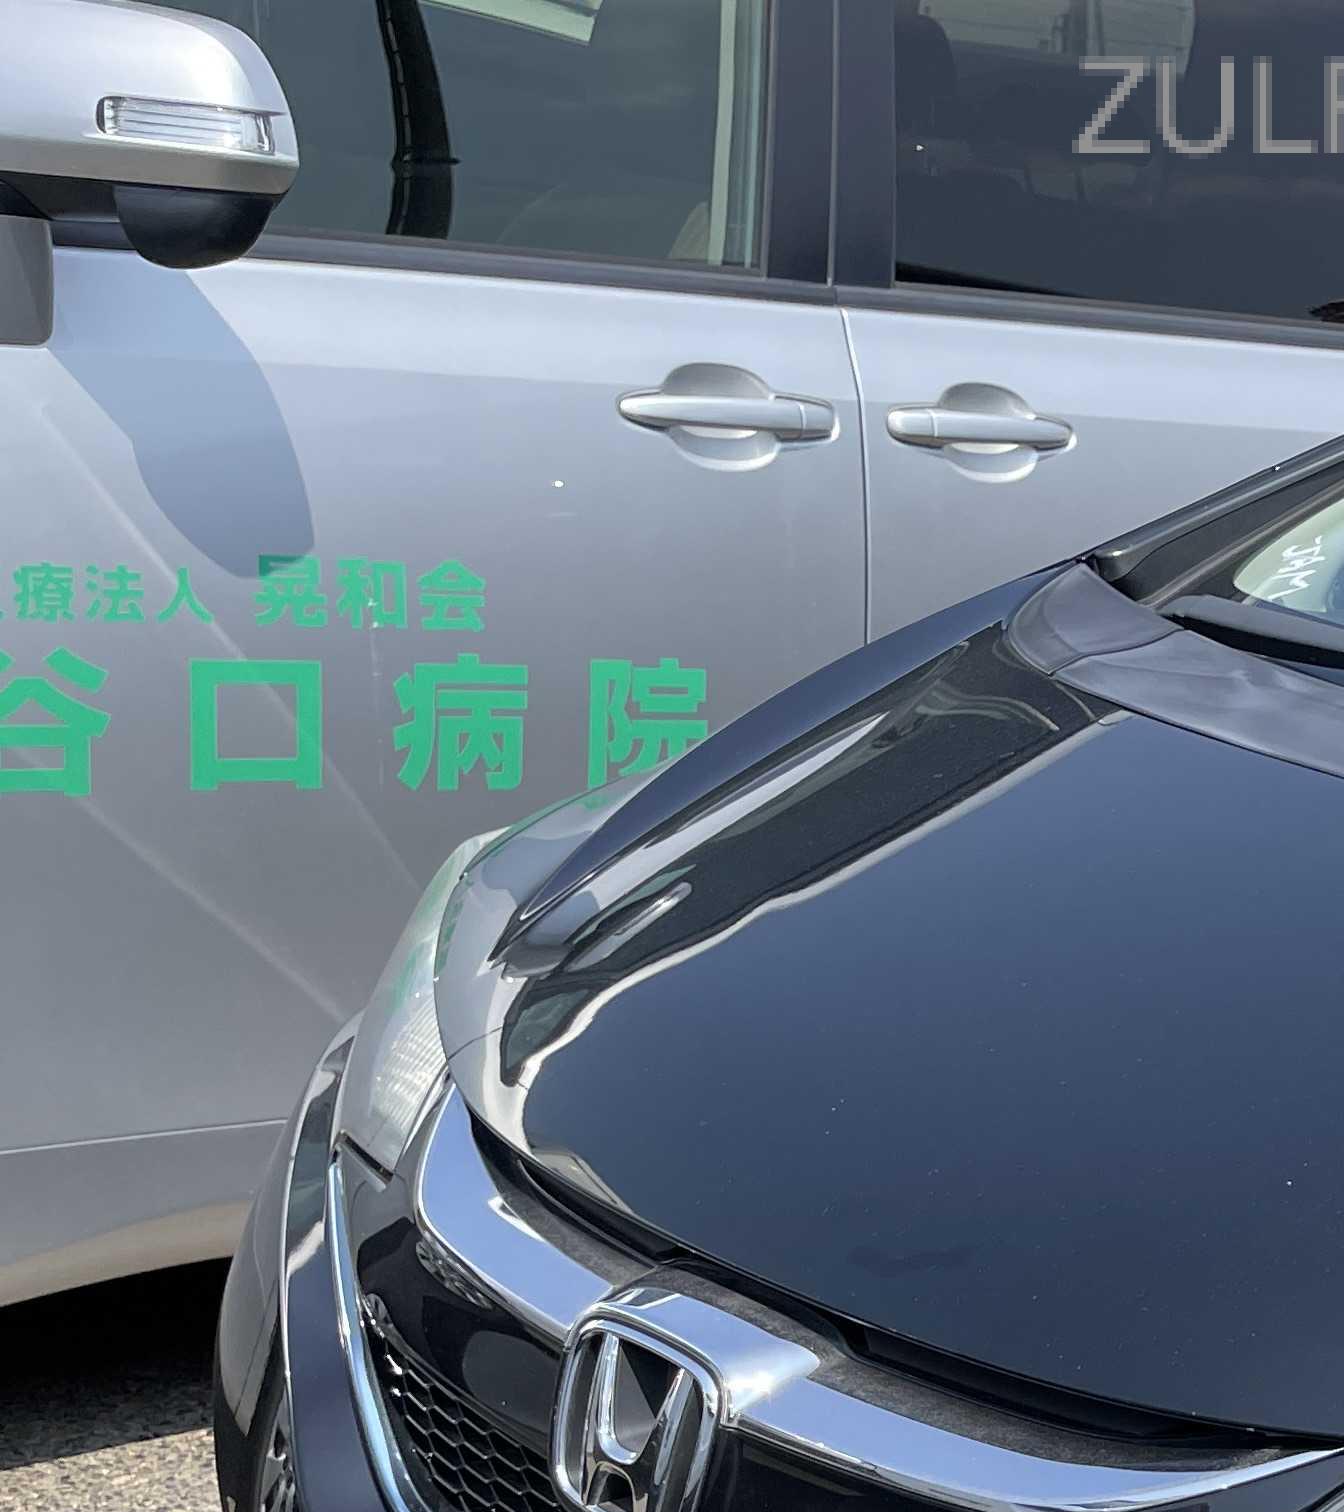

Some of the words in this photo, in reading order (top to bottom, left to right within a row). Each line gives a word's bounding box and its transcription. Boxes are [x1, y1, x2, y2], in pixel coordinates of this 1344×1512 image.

[0, 562, 214, 624] 療法人
[253, 553, 487, 632] 晃和会
[0, 646, 709, 797] 谷口病院
